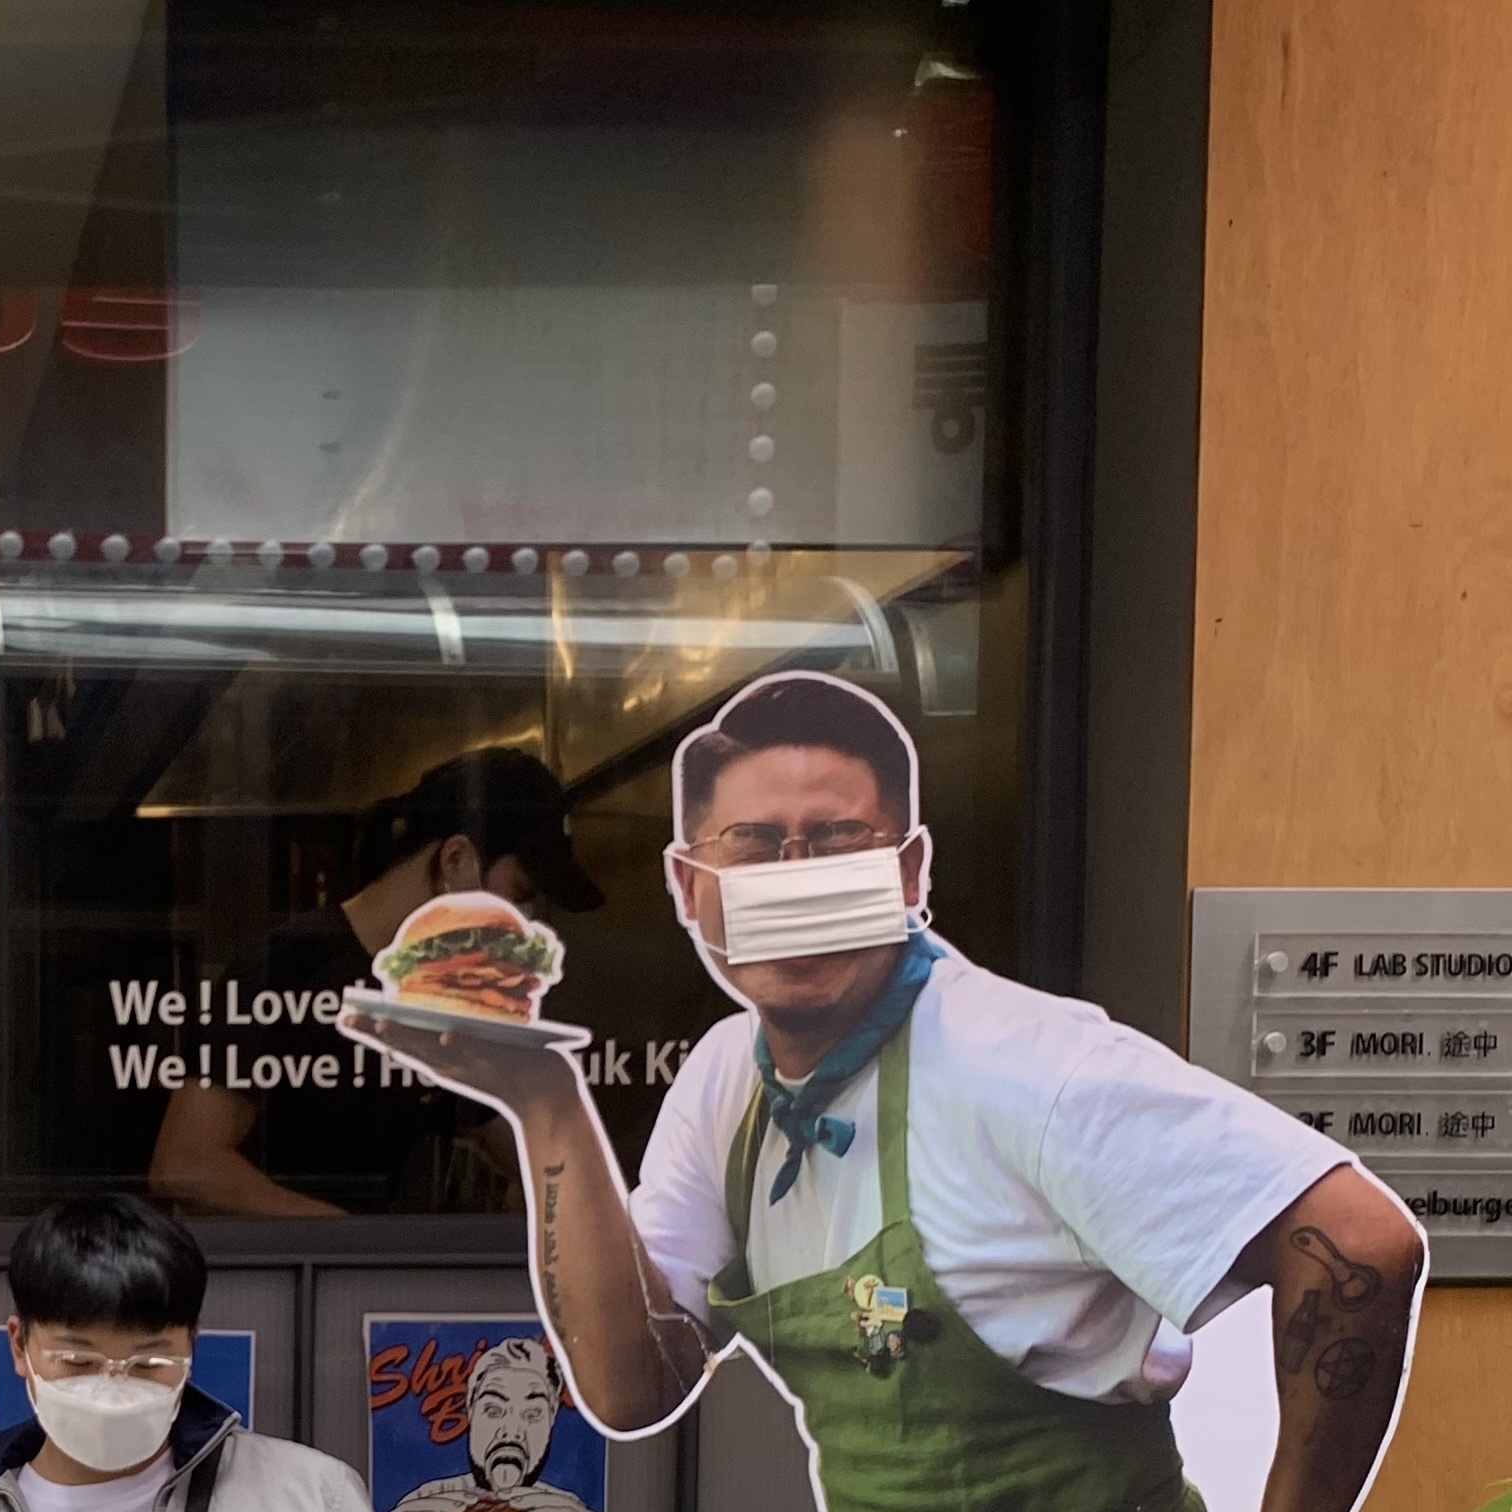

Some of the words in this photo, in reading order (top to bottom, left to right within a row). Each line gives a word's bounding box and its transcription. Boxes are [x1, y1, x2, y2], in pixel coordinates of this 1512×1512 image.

[1300, 952, 1338, 977] 4F
[1356, 954, 1406, 976] LAB
[1415, 953, 1512, 976] STUDIO
[1299, 1030, 1336, 1057] 3F
[1444, 1030, 1497, 1057] 途中
[1442, 1111, 1495, 1138] 途中
[1405, 1190, 1512, 1223] eburg
[370, 1338, 488, 1411] Shri
